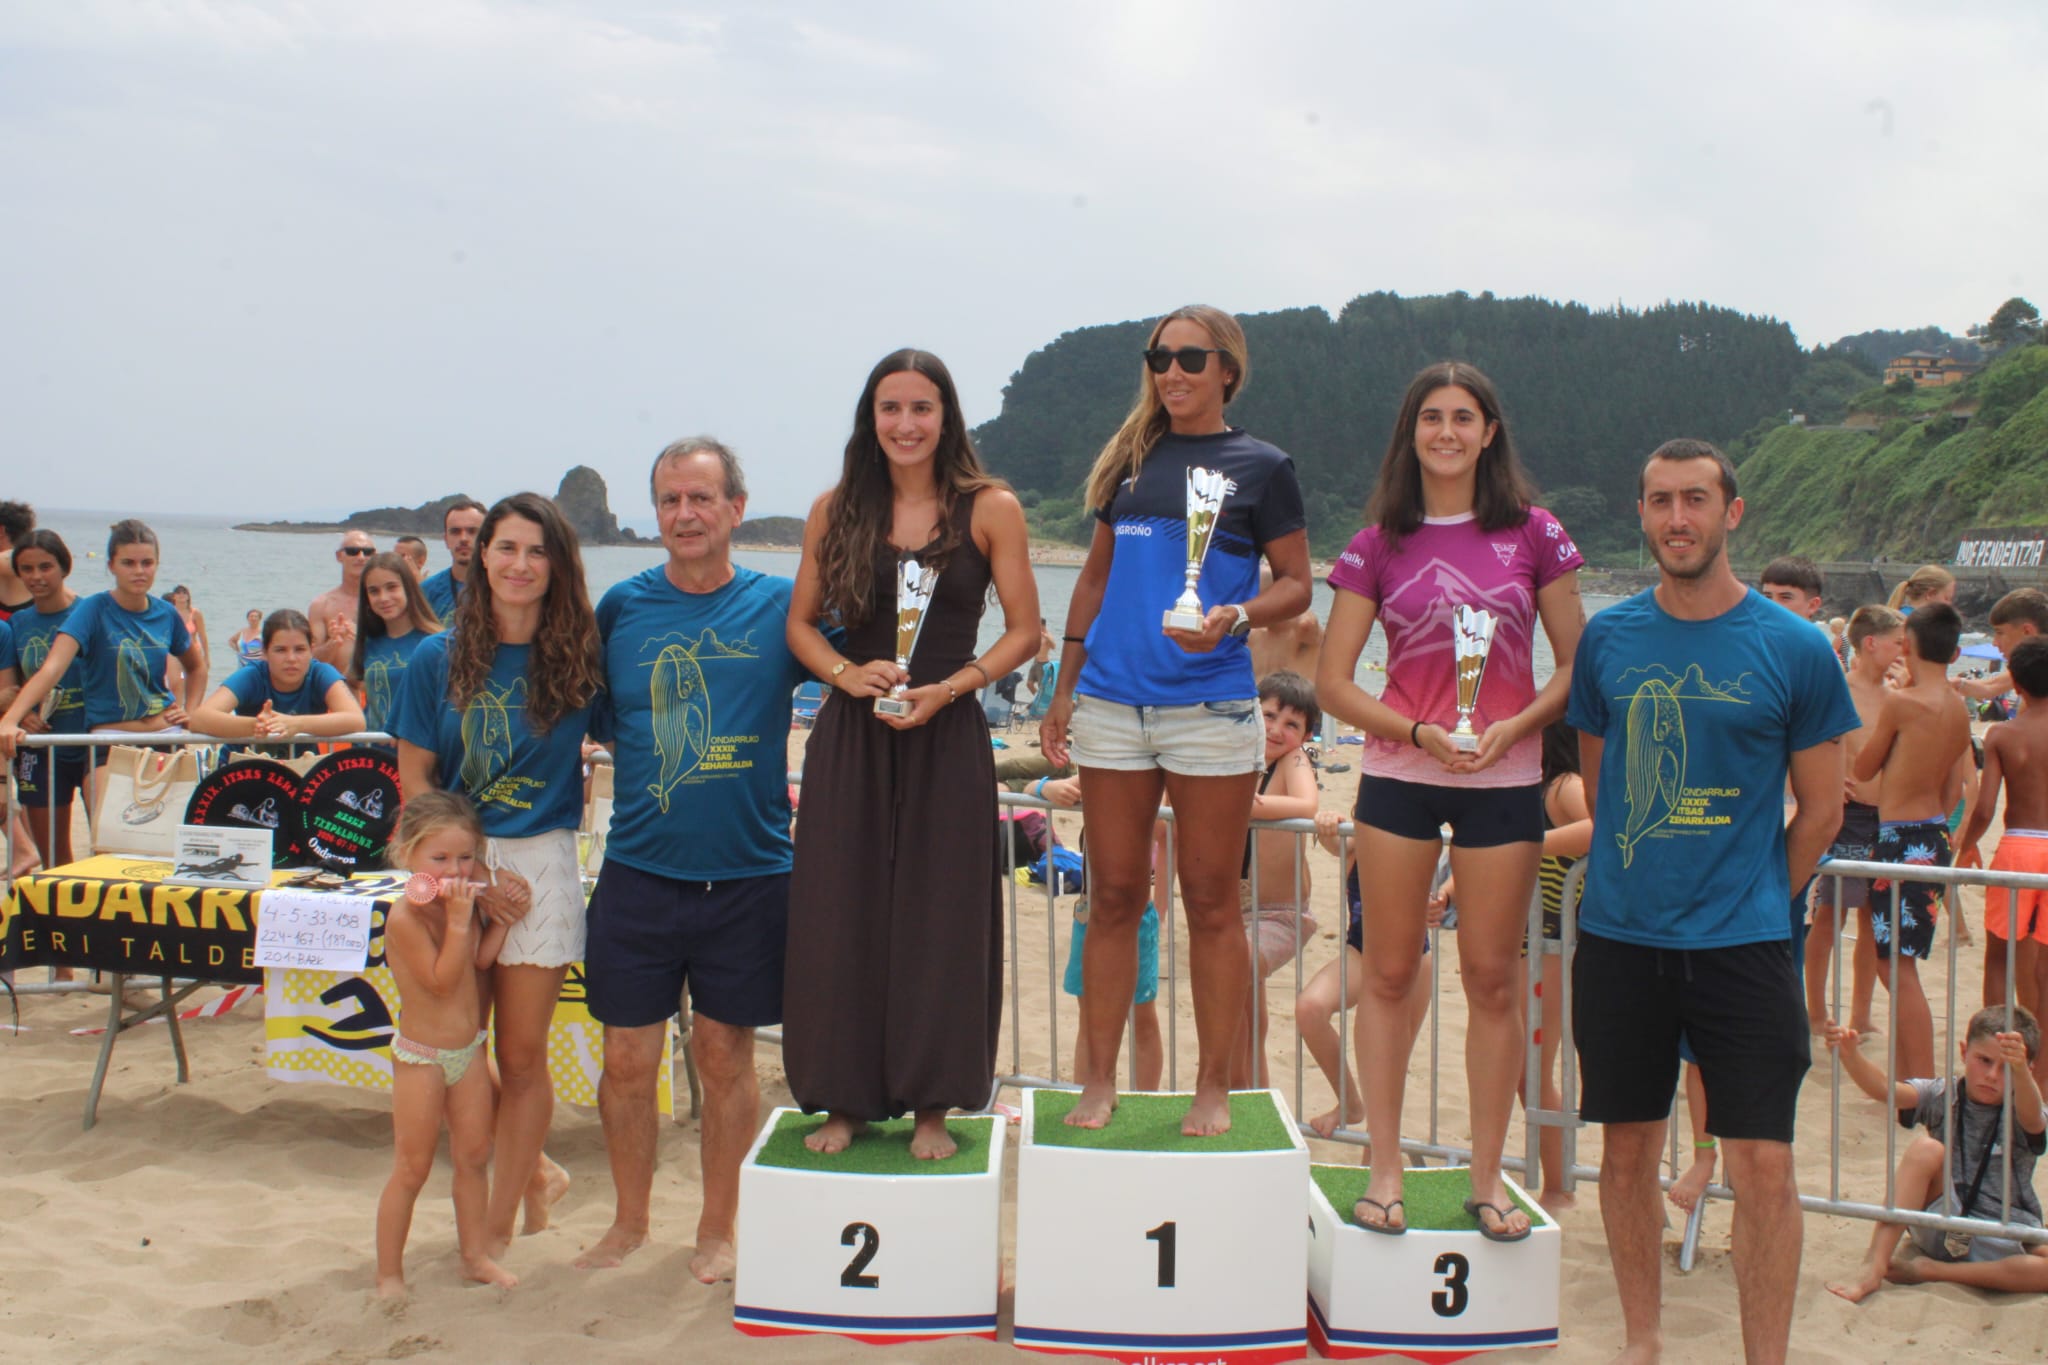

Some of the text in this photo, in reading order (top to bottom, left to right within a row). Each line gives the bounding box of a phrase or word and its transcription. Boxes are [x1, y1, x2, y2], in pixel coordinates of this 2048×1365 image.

[1956, 540, 2045, 567] INDEPENDENTZIA
[711, 735, 759, 744] ONDARRUKO
[337, 757, 374, 772] ITSAS
[700, 760, 752, 770] ZEHARKALDIA
[706, 753, 732, 761] ITSAS
[221, 769, 262, 786] ITSAS
[1682, 787, 1740, 797] ONDARRUKO
[1677, 807, 1704, 816] ITSAS
[1669, 815, 1731, 825] ZEHARKALDIA
[0, 876, 262, 940] NDARR
[1, 930, 256, 969] ERI TALDE
[840, 1221, 880, 1289] 2
[1145, 1221, 1176, 1288] 1
[1431, 1252, 1470, 1318] 3
